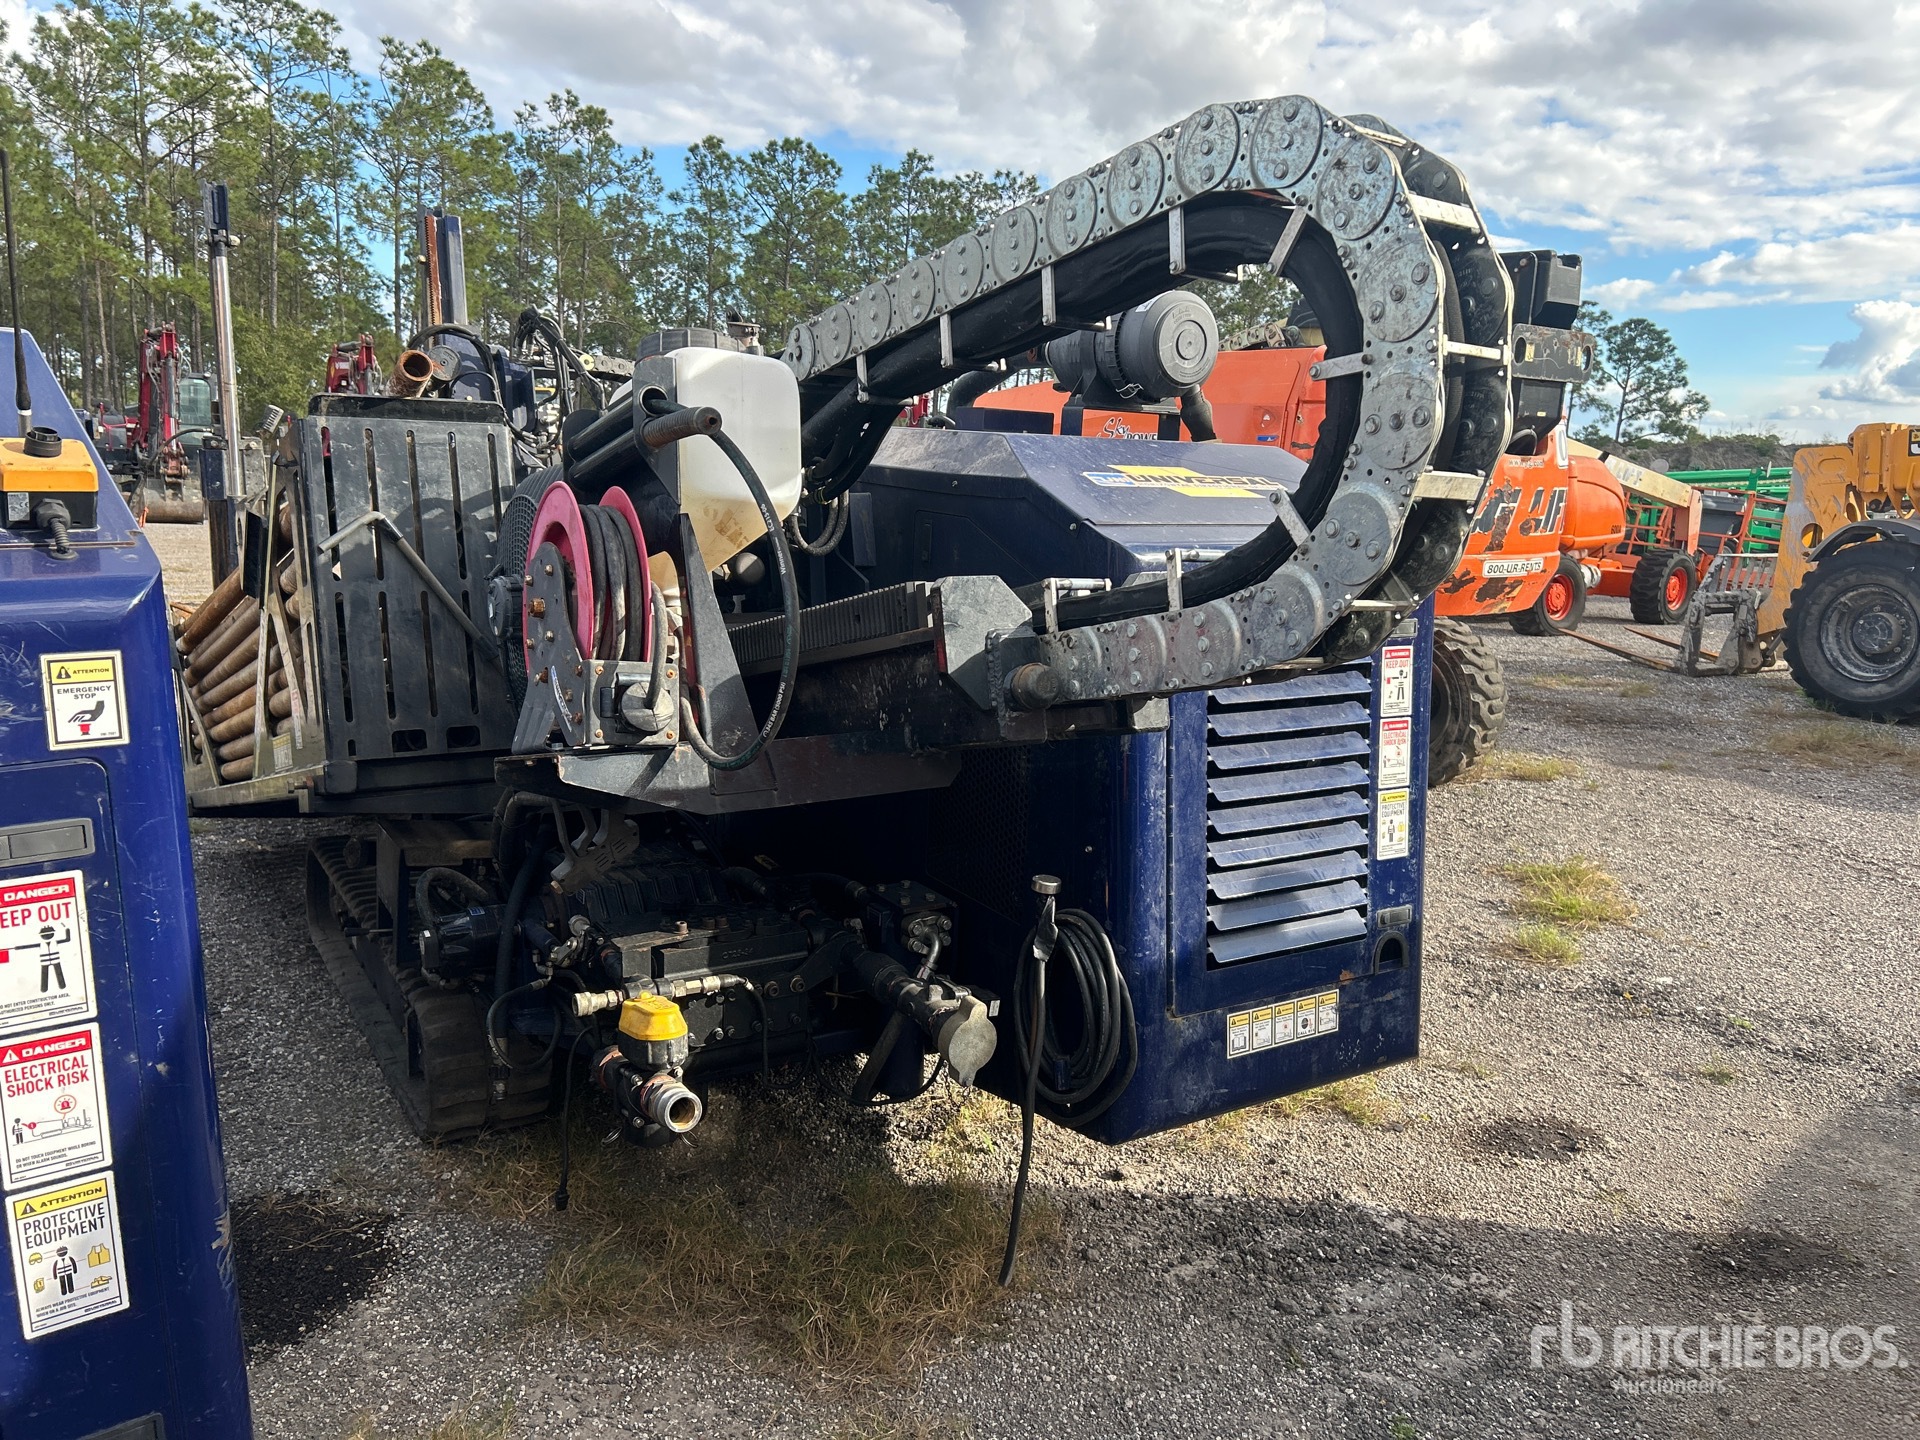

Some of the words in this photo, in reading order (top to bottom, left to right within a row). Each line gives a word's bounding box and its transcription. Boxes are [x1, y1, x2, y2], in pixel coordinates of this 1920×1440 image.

[1126, 475, 1280, 486] UNIVERSAL
[777, 550, 787, 575] Winner
[1486, 561, 1541, 574] 800-UR-RENTS
[57, 685, 111, 694] EMERGENCY
[3, 884, 70, 902] DANGER
[0, 908, 31, 929] EEP
[38, 902, 71, 922] OUT
[21, 1037, 86, 1058] DANGER
[4, 1055, 89, 1084] ELECTRICAL
[7, 1076, 54, 1098] SHOCK
[57, 1068, 90, 1087] RISK
[40, 1186, 103, 1208] ATTENTION
[23, 1202, 105, 1235] PROTECTIVE
[25, 1215, 105, 1250] EQUIPMENT
